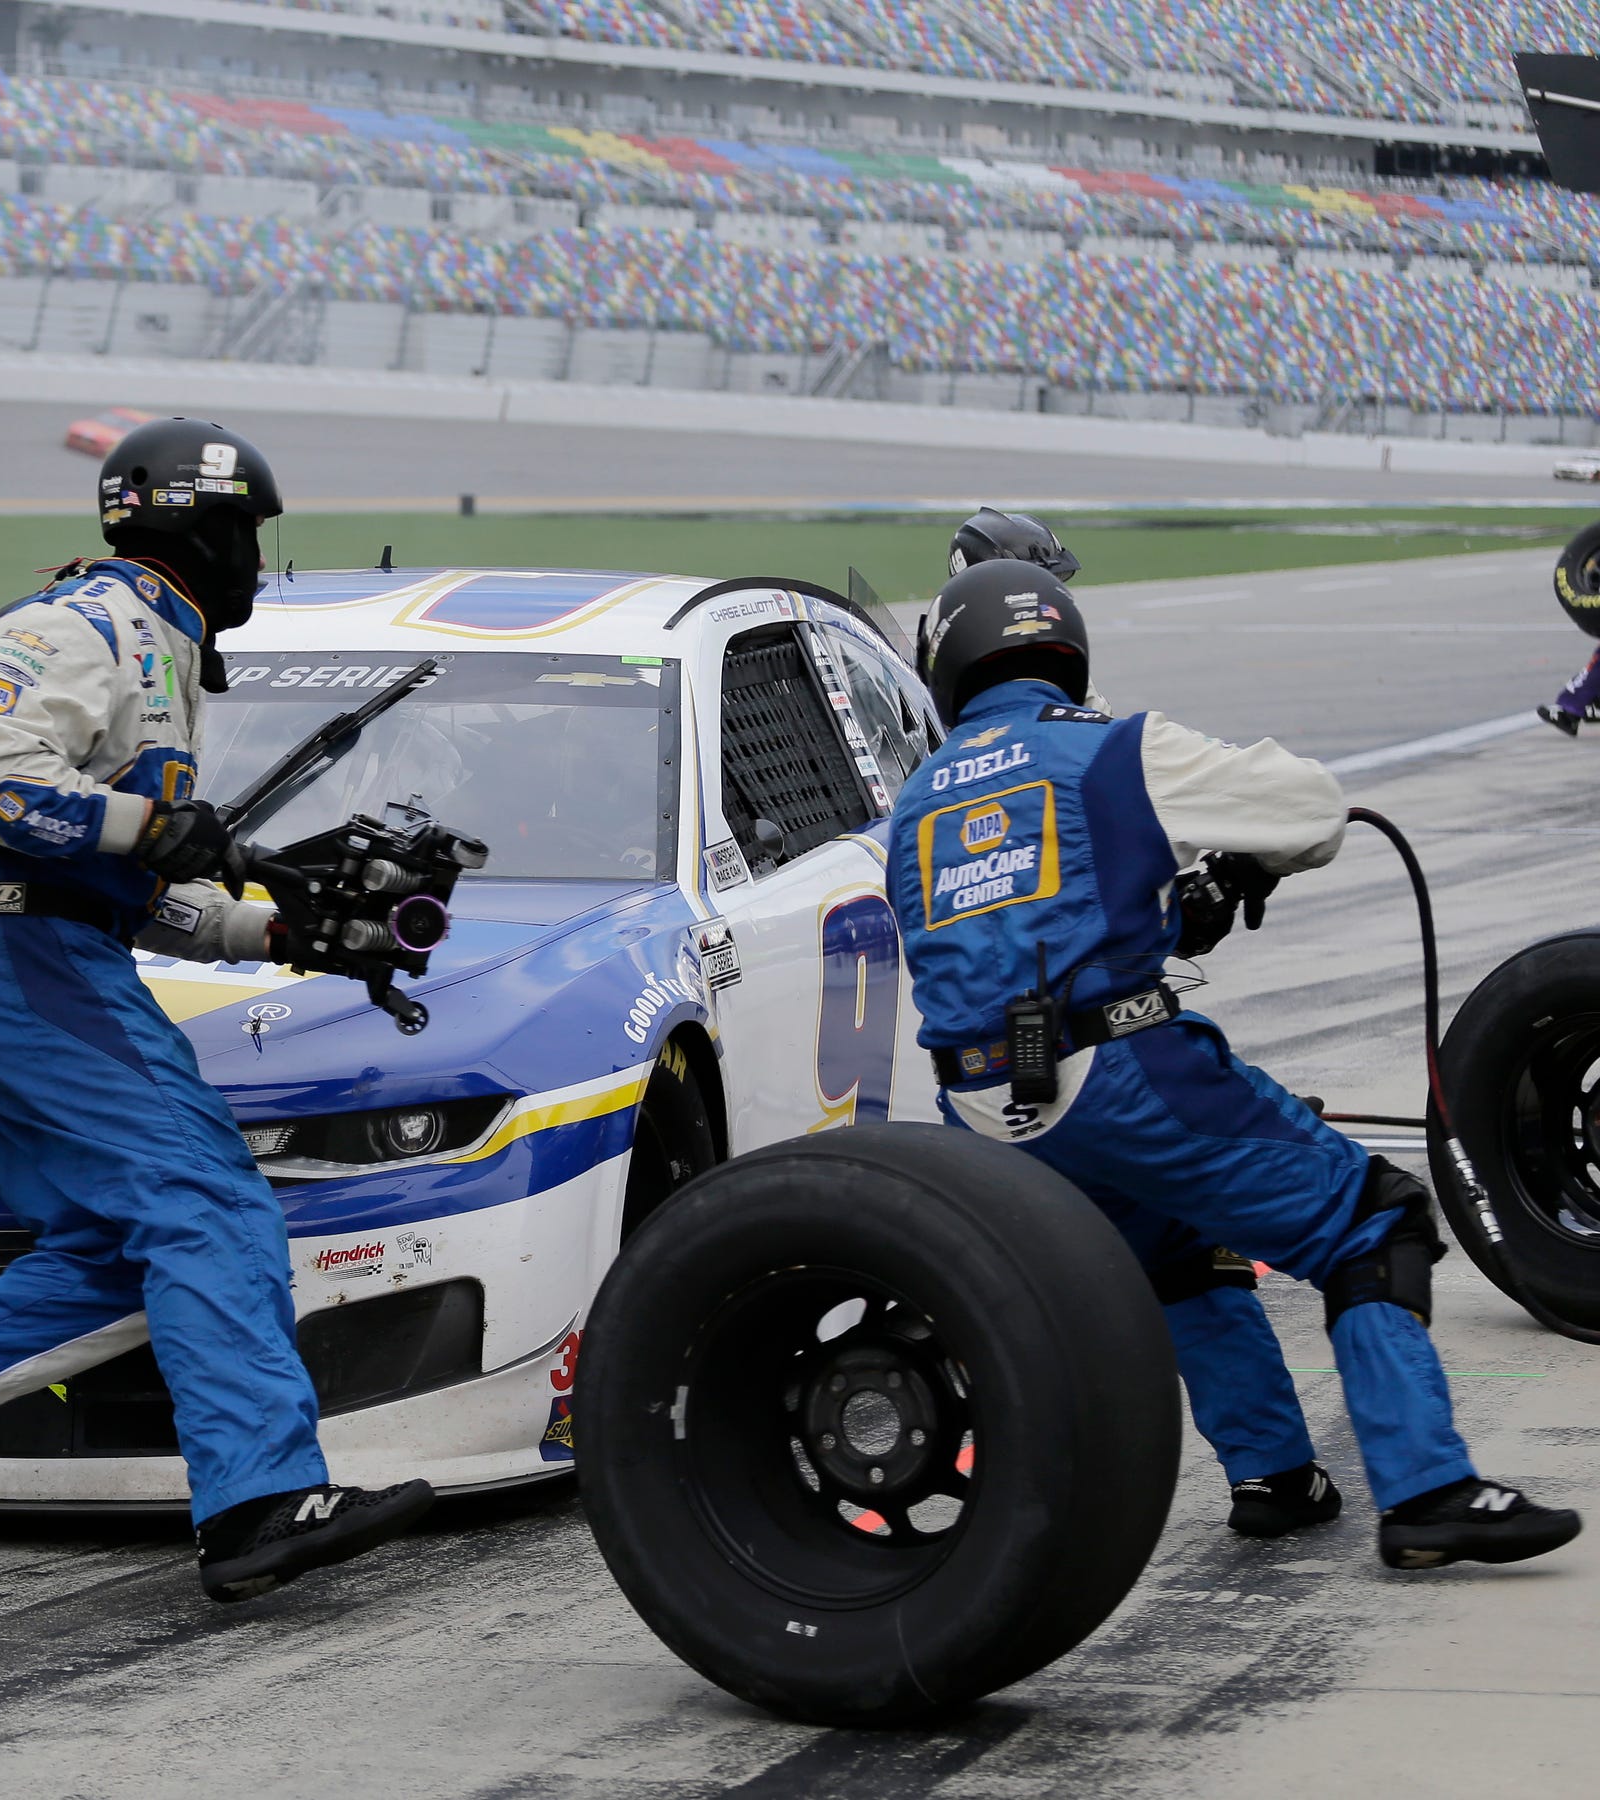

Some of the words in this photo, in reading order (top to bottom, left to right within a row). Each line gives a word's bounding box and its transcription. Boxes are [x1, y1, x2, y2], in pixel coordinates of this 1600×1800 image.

[200, 443, 238, 478] 9
[709, 607, 740, 622] CHASE
[270, 666, 447, 688] SERIES
[1051, 708, 1066, 716] 9
[932, 743, 1030, 790] O'DELL
[967, 813, 1003, 843] NAPA
[953, 876, 1014, 910] CENTER
[814, 882, 903, 1133] 9
[318, 1241, 385, 1271] Hendrick
[328, 1257, 383, 1271] MOTORSPORTS
[550, 1330, 585, 1391] 3
